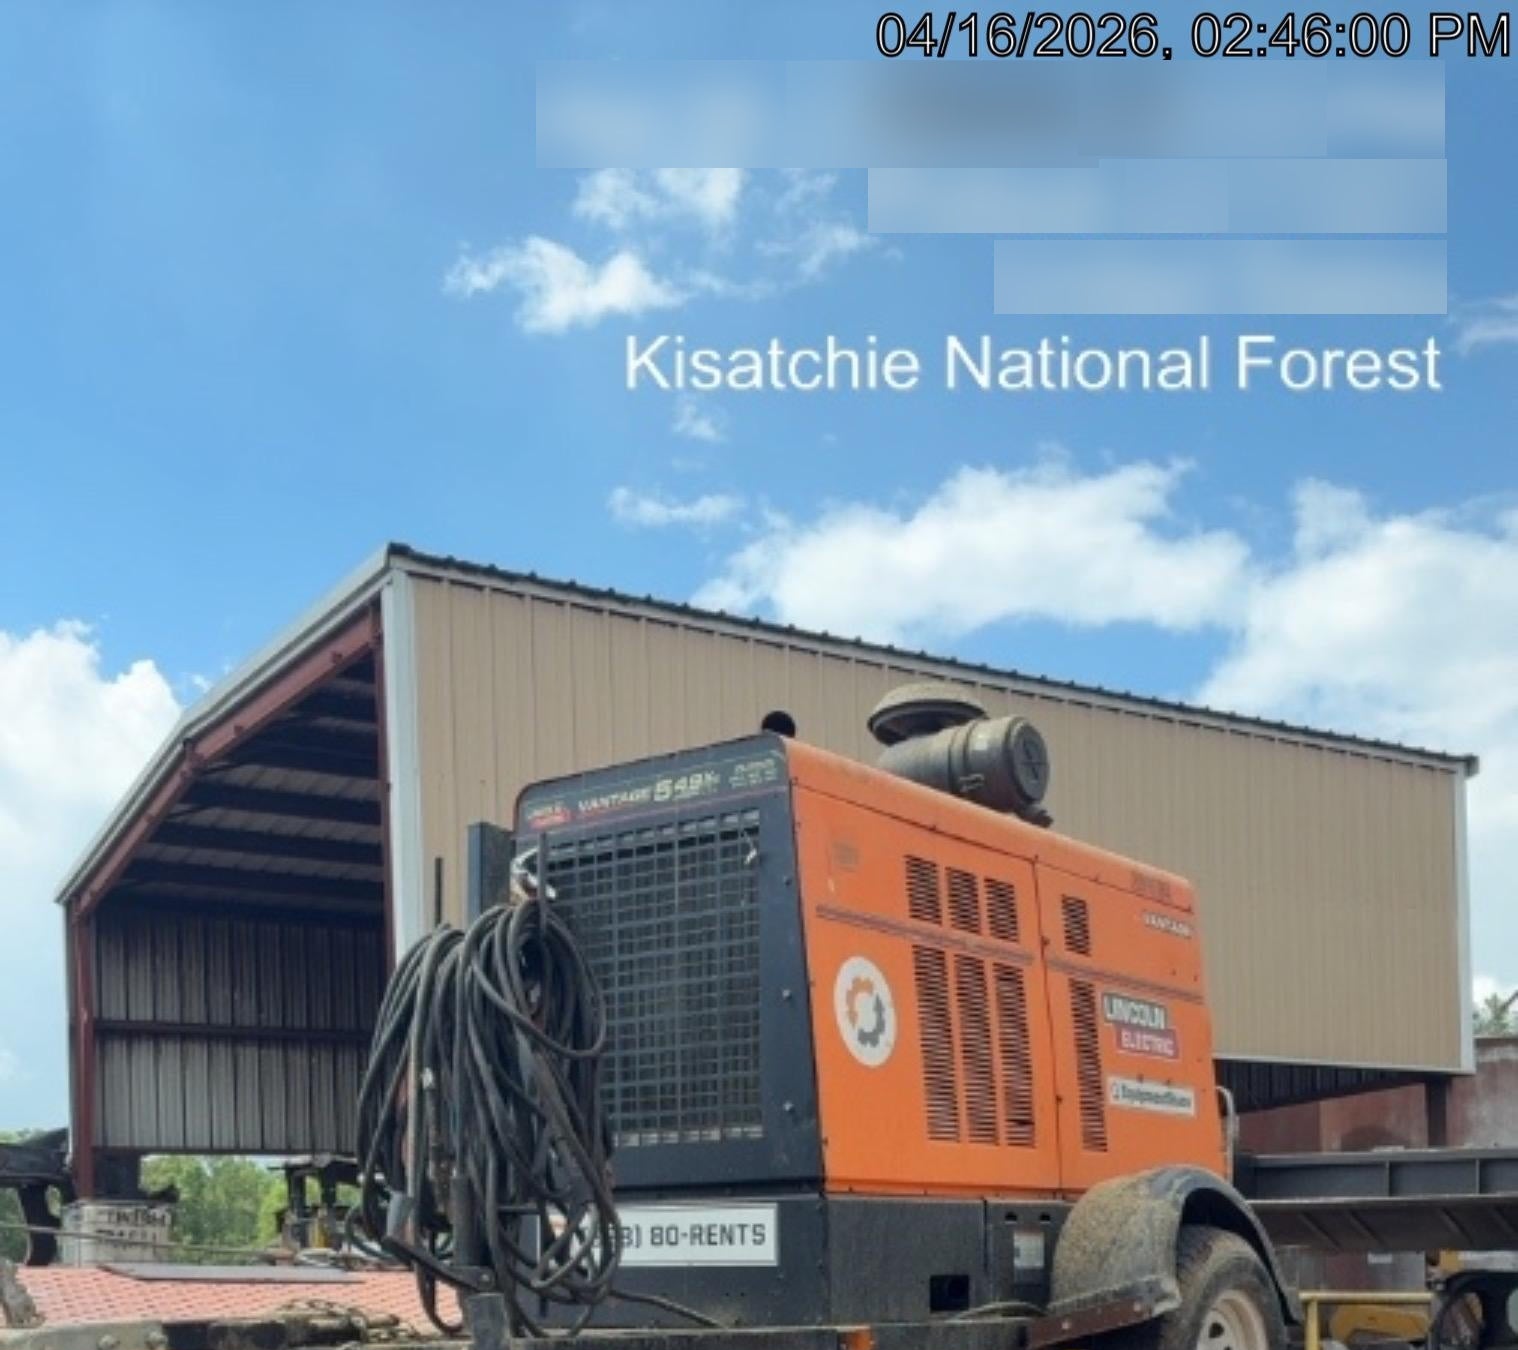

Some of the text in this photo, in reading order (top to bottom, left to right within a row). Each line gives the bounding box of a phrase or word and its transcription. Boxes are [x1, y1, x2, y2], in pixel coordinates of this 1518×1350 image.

[1103, 995, 1166, 1030] LINCOLN
[1121, 1028, 1175, 1057] ELECTRIC
[650, 1223, 766, 1246] 80-RENTS
